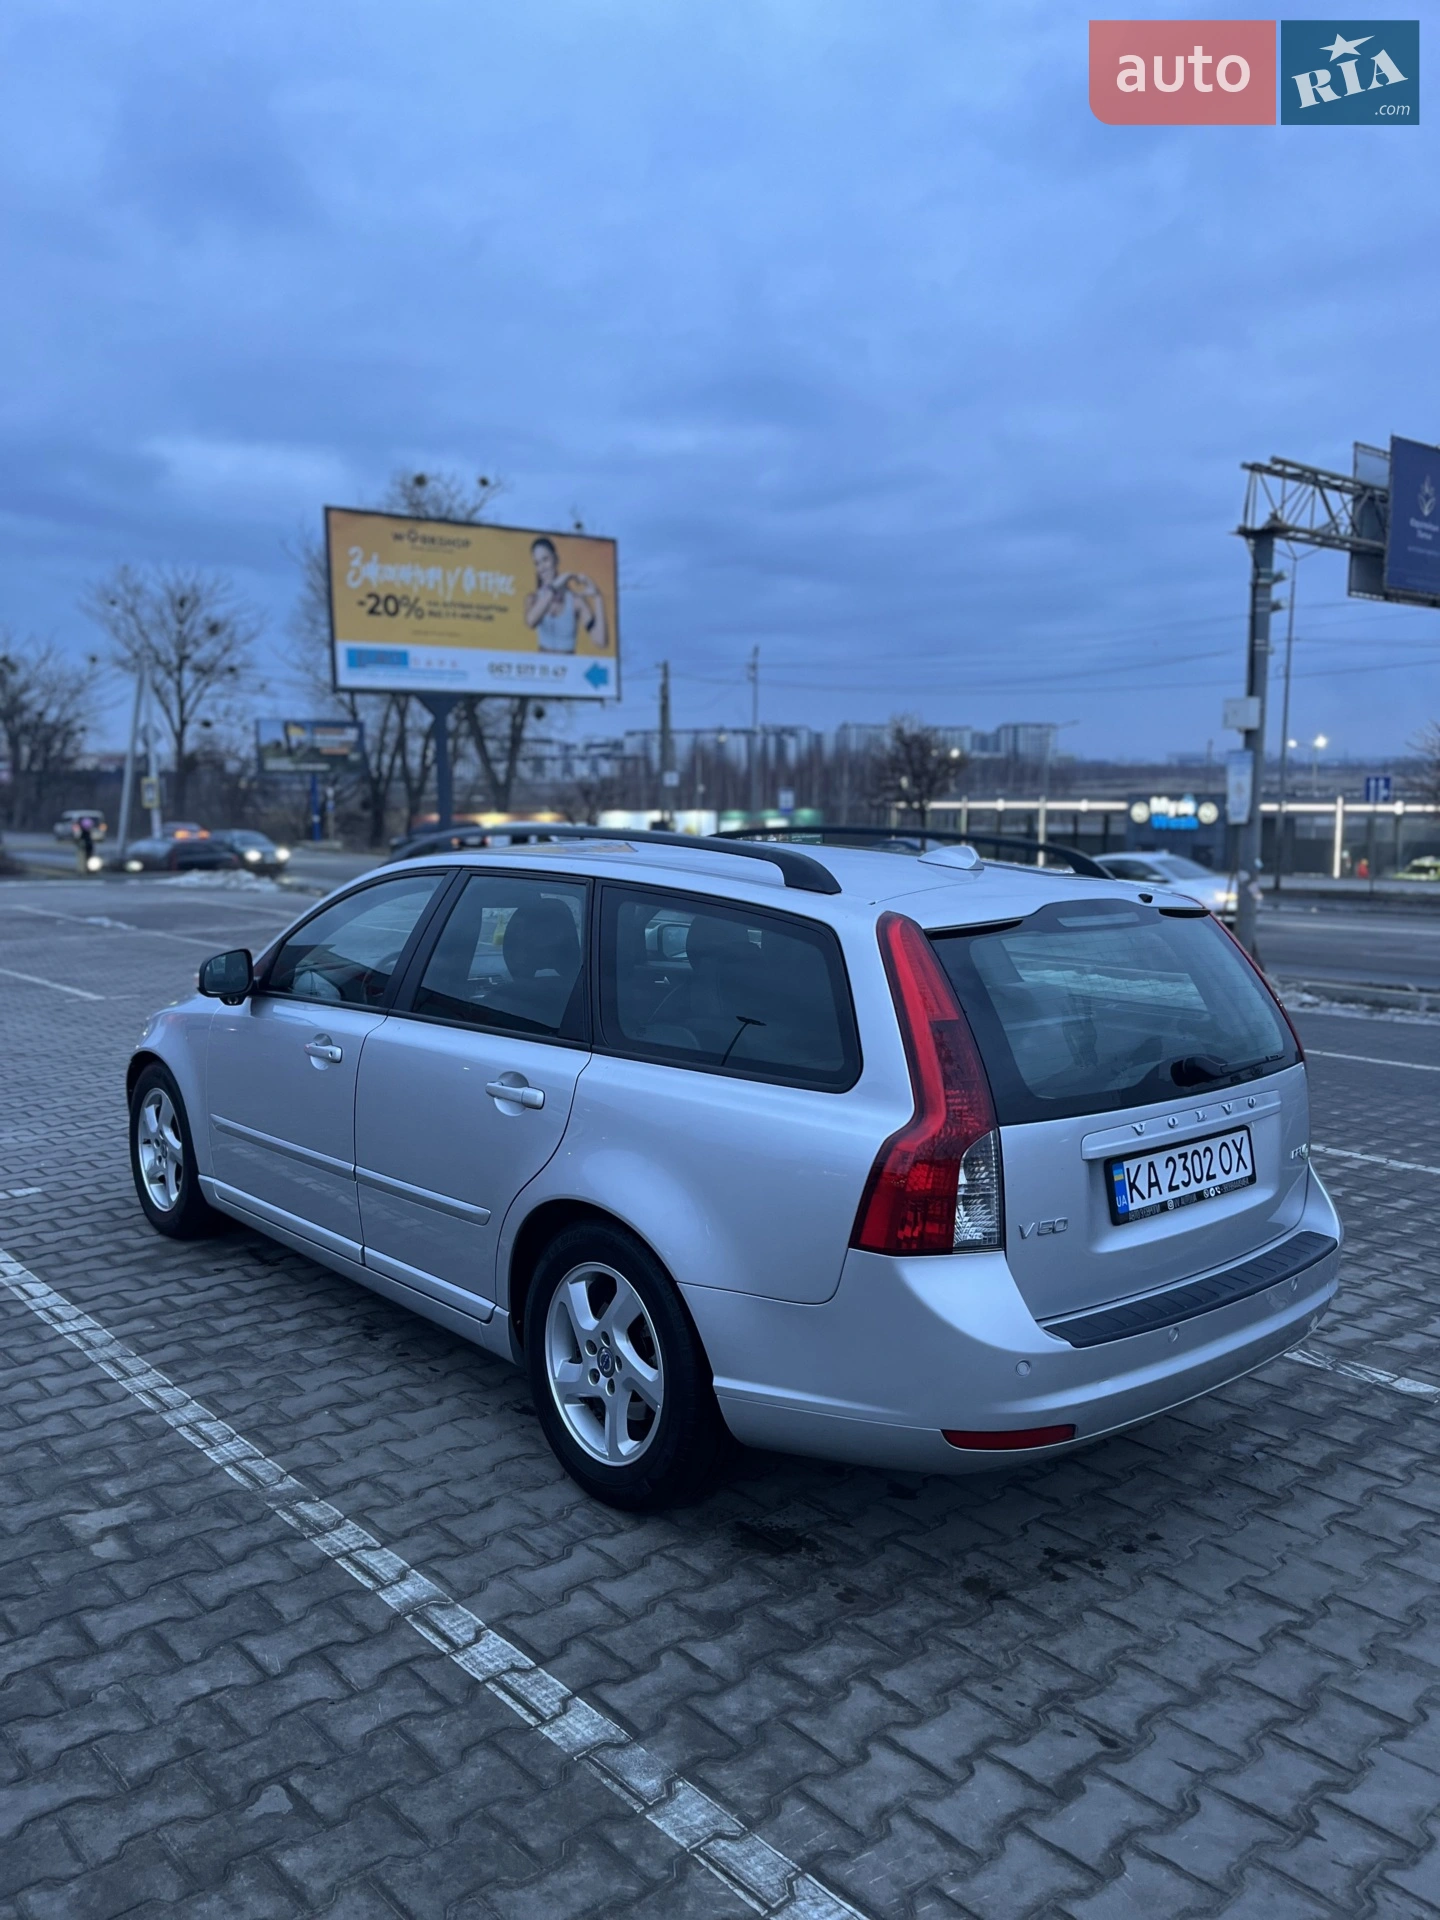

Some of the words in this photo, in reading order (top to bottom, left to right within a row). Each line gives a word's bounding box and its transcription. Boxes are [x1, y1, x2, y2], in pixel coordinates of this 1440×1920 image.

[357, 593, 425, 620] -20%
[1132, 1096, 1258, 1135] VOLVO
[1126, 1160, 1163, 1204] KA
[1165, 1147, 1217, 1193] 2302
[1219, 1136, 1249, 1176] OX
[1116, 1195, 1128, 1207] UA
[1018, 1216, 1069, 1239] V50
